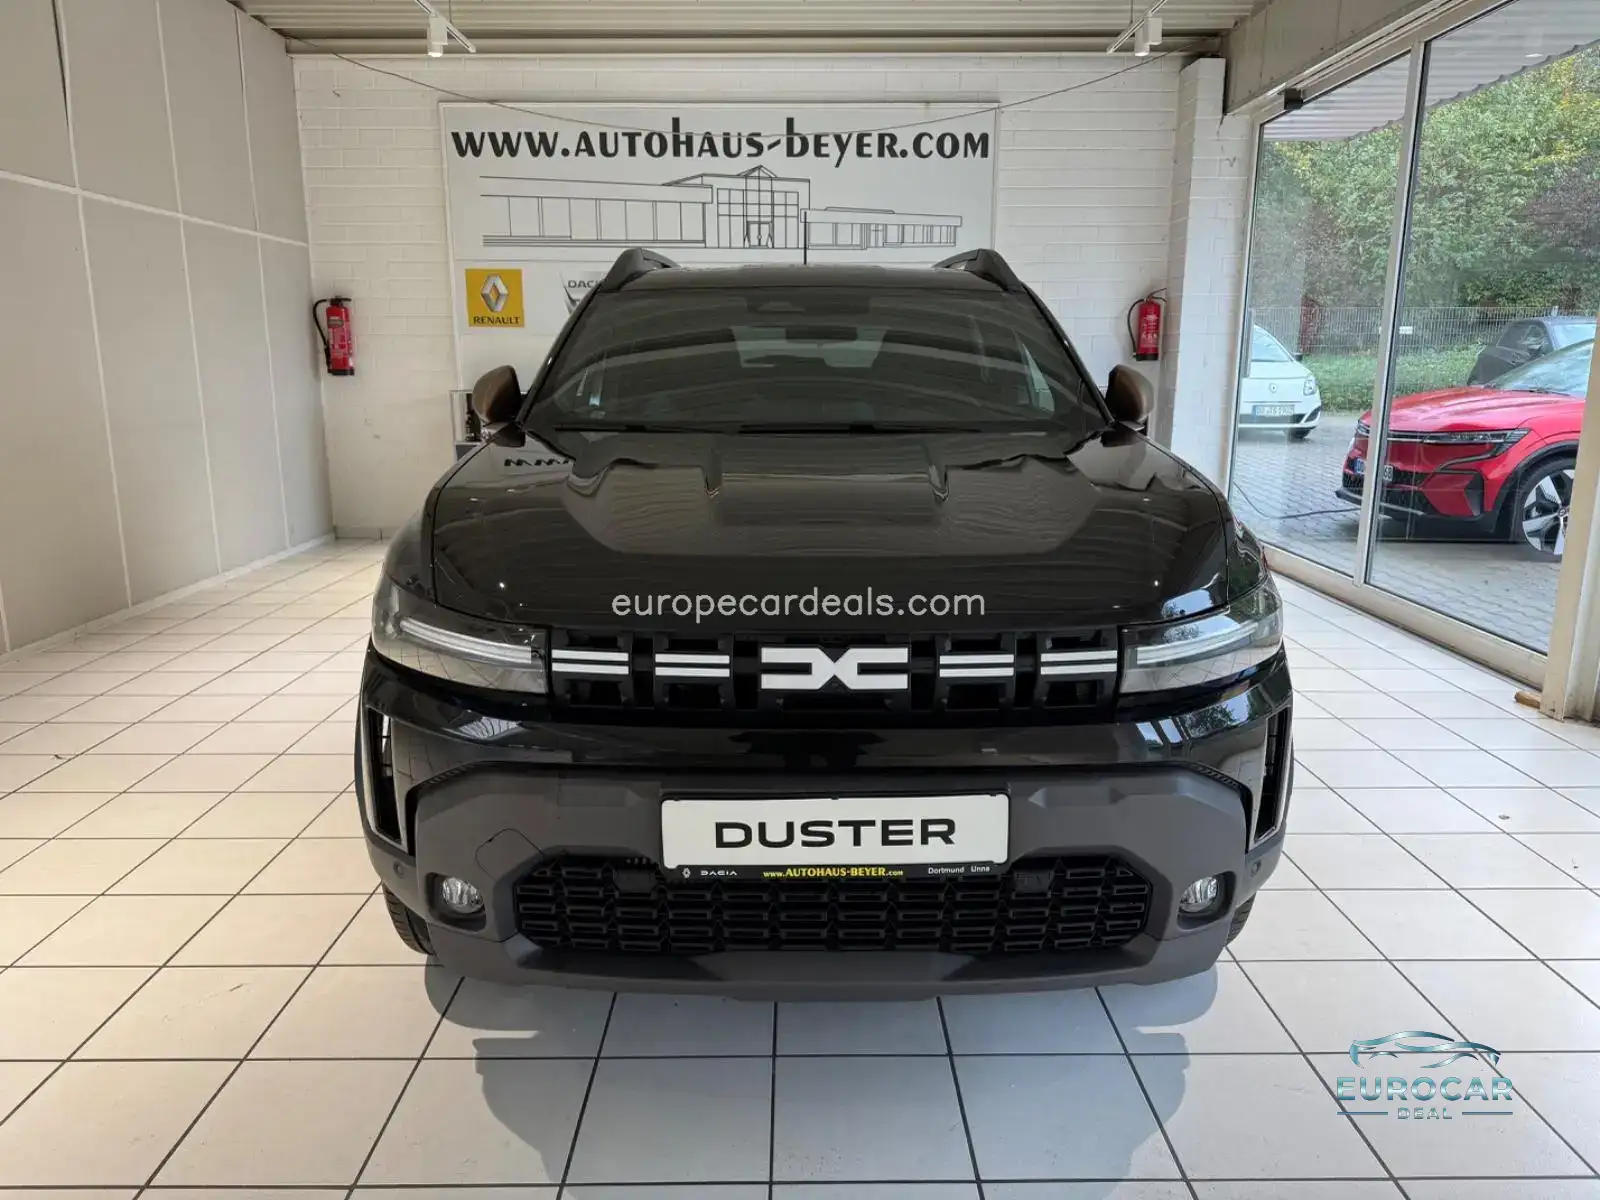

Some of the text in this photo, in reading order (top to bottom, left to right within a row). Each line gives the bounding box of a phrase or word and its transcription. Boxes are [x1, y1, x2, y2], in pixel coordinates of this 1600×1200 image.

[473, 316, 521, 326] RENAULT
[715, 818, 956, 849] DUSTER
[700, 869, 738, 877] DACIA
[762, 865, 904, 878] www.AUTOHAUS-BEYER.com
[927, 864, 991, 875] Dortmund Unna
